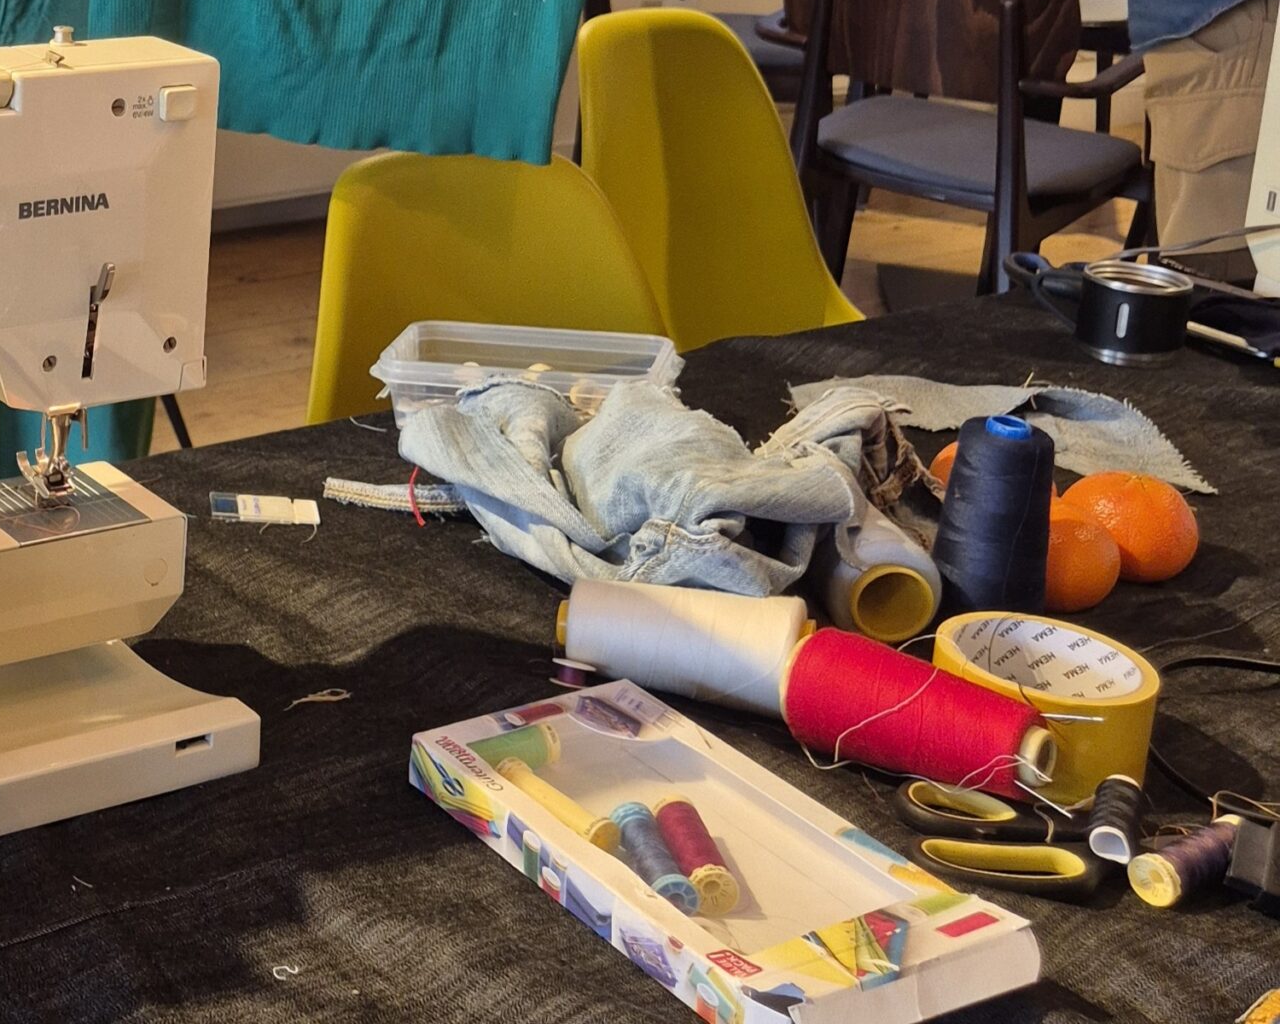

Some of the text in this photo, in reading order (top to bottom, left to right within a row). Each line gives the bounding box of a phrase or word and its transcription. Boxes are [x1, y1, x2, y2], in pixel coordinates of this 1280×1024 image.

[18, 192, 110, 219] BERNINA
[998, 619, 1025, 638] HEMA
[1067, 636, 1092, 651] HEMA
[971, 645, 988, 663] HEM
[994, 645, 1021, 666] HEMA
[1027, 651, 1057, 670] HEMA
[1097, 650, 1120, 665] HEMA
[1062, 662, 1090, 680] HEMA
